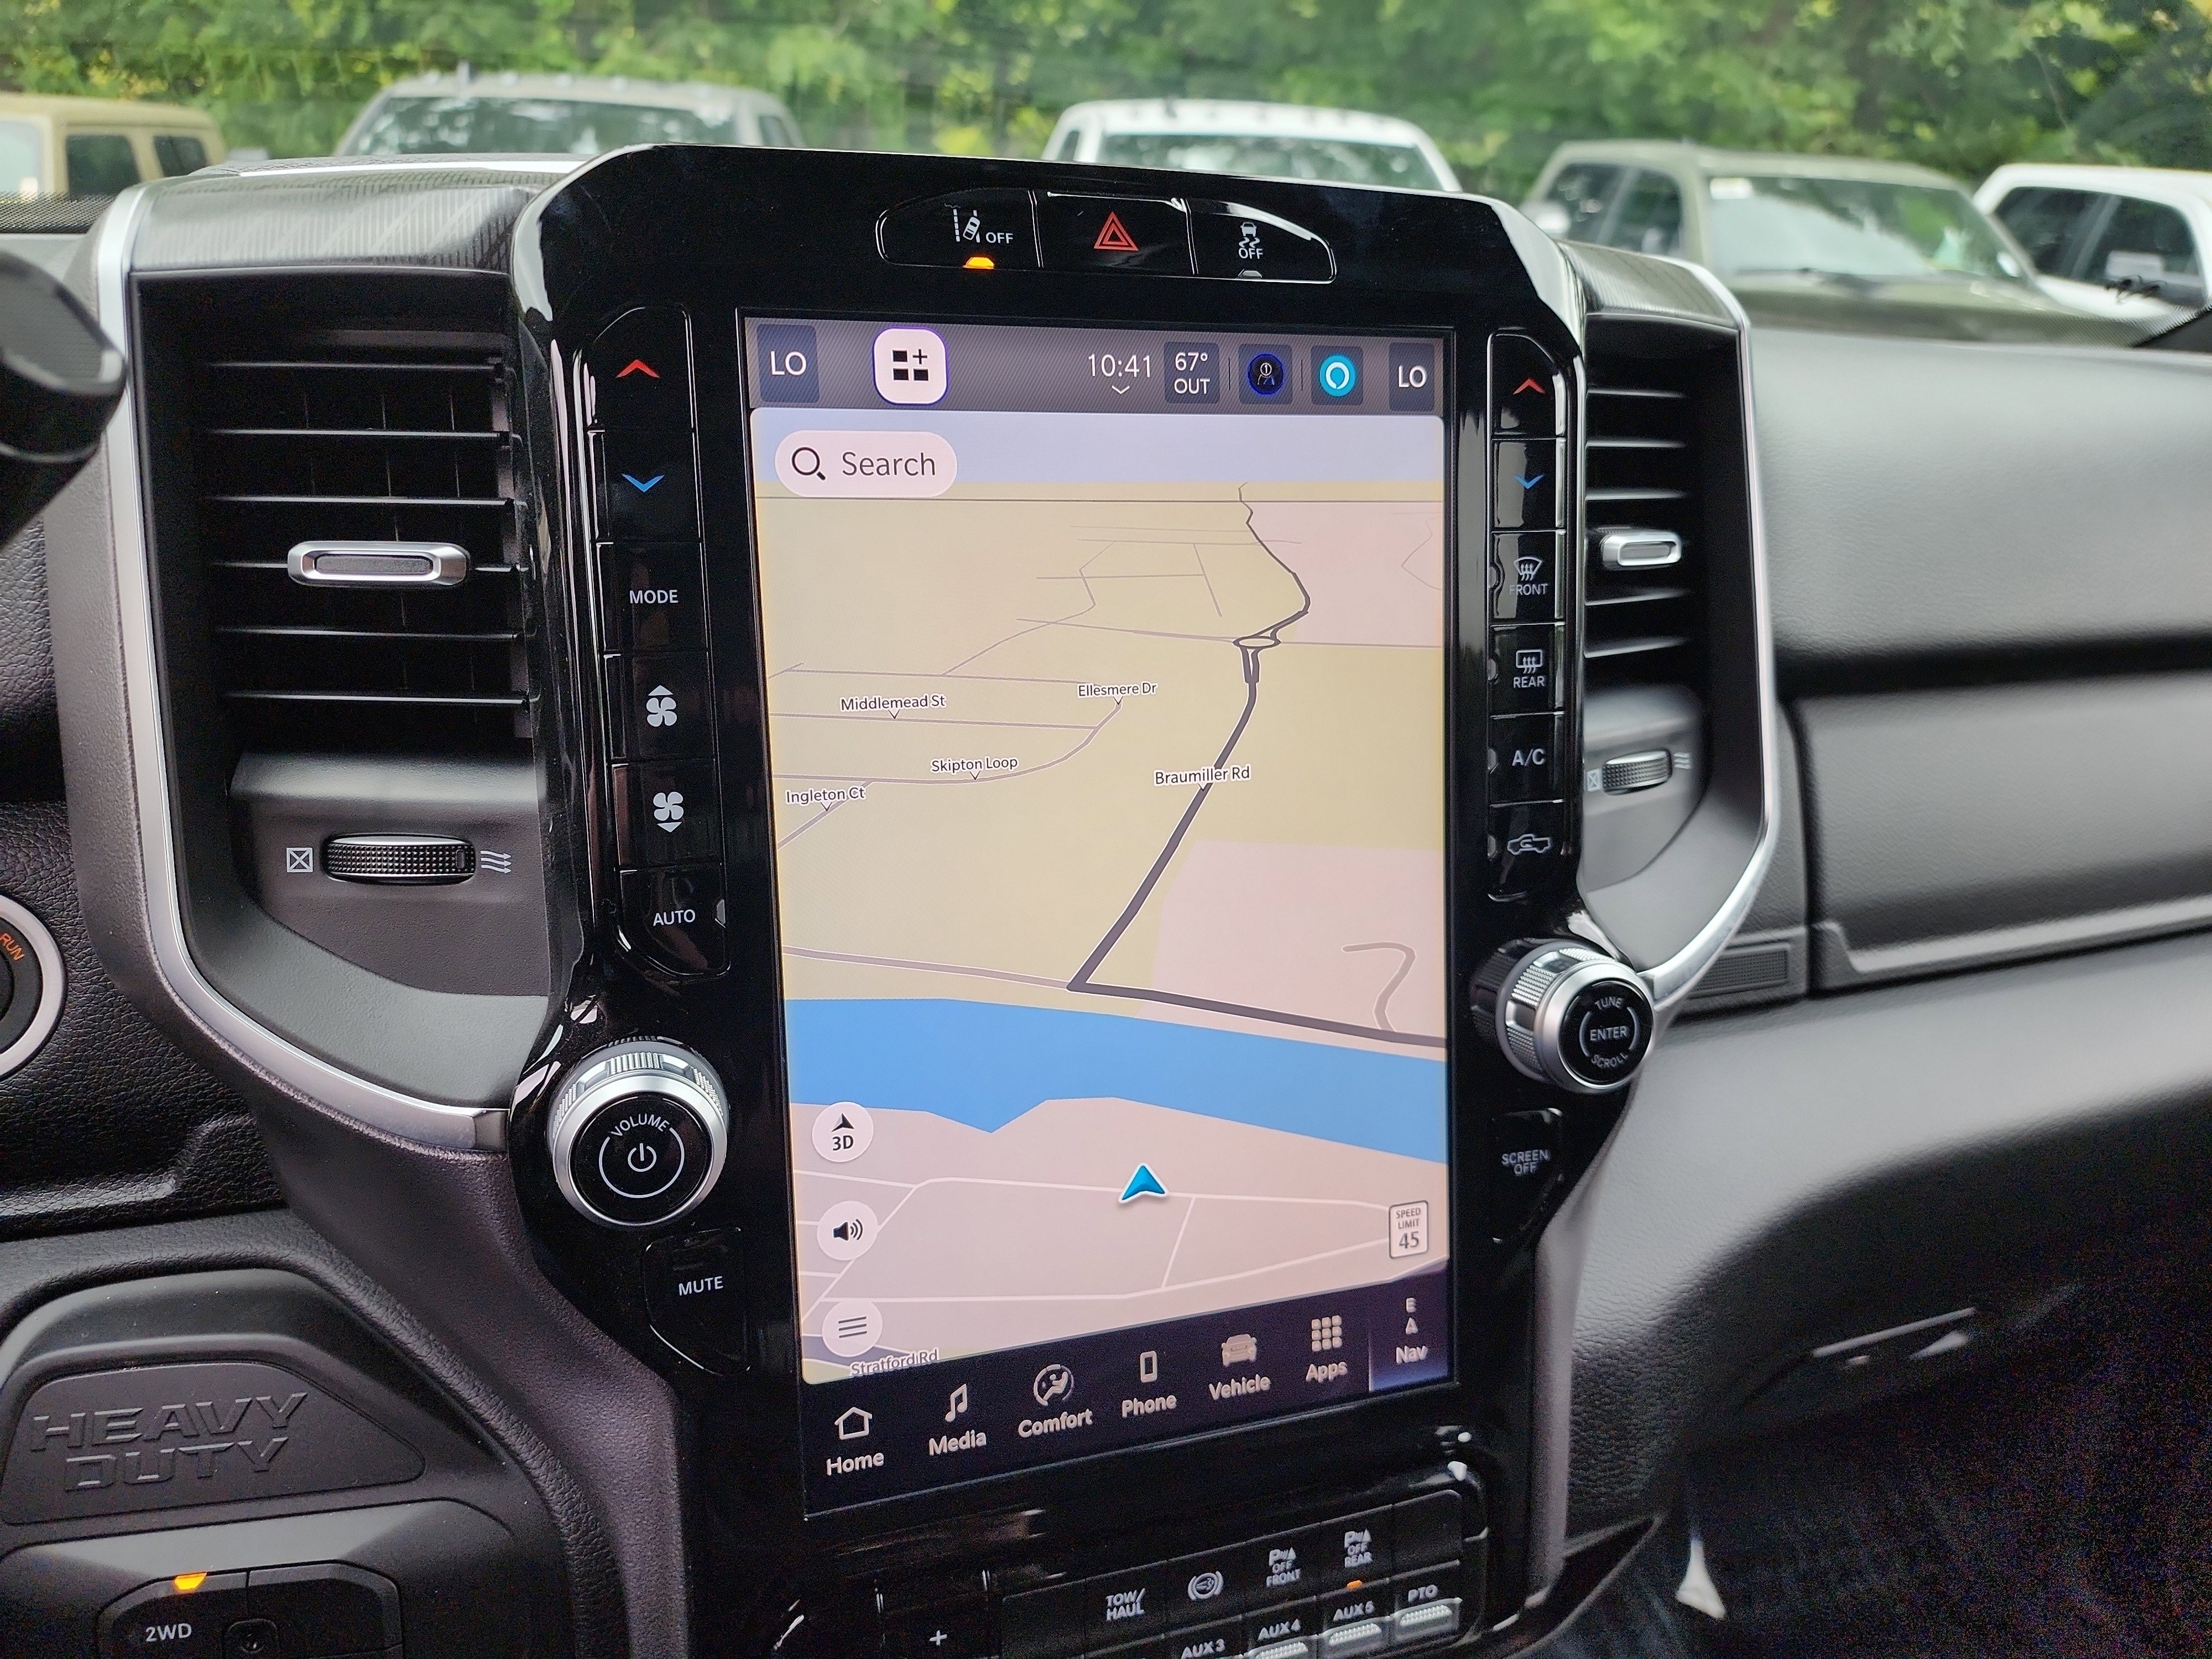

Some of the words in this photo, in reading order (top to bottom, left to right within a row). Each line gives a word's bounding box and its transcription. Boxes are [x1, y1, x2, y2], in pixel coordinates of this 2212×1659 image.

[986, 232, 1014, 244] OFF
[1238, 247, 1263, 260] OFF
[770, 351, 807, 377] LO
[1087, 354, 1152, 378] 10:41
[1175, 352, 1209, 372] 67°
[1174, 378, 1211, 395] OUT
[1397, 365, 1427, 388] LO
[841, 451, 936, 477] Search
[629, 589, 679, 604] MODE
[1509, 583, 1549, 596] FRONT
[1078, 685, 1139, 697] Ellesmere
[1142, 682, 1157, 694] Dr
[1512, 676, 1546, 689] REAR
[840, 696, 928, 712] Middlemead
[931, 695, 946, 707] St
[931, 758, 983, 773] Skipton
[986, 757, 1019, 771] Loop
[1511, 748, 1546, 767] A/C
[1155, 768, 1228, 785] Braumiller
[1232, 765, 1250, 779] Rd
[786, 789, 846, 805] Ingleton
[849, 786, 865, 800] Ct
[652, 909, 696, 927] AUTO
[1594, 995, 1623, 1011] TUNE
[1589, 1025, 1628, 1042] ENTER
[1590, 1051, 1630, 1068] SCROLL
[611, 1113, 671, 1139] VOLUME
[832, 1134, 854, 1152] 3D
[1501, 1149, 1550, 1166] SCREEN
[1513, 1163, 1537, 1177] OFF
[1395, 1207, 1421, 1219] SPEED
[1397, 1218, 1420, 1230] LIMIT
[1398, 1230, 1420, 1249] 45
[678, 1275, 724, 1296] MUTE
[850, 1351, 917, 1376] Stratford
[918, 1348, 940, 1365] Rd
[1395, 1345, 1428, 1365] Nav
[1306, 1360, 1348, 1383] Apps
[1209, 1373, 1271, 1401] Vehicle
[1121, 1392, 1177, 1418] Phone
[29, 1392, 308, 1452] HEAVY
[1018, 1408, 1093, 1438] Comfort
[928, 1430, 987, 1456] Media
[64, 1437, 289, 1493] DUTY
[826, 1450, 885, 1476] Home
[1344, 1552, 1374, 1568] REAR
[1266, 1568, 1301, 1588] FRONT
[1105, 1588, 1146, 1608] TOW/
[1407, 1584, 1438, 1604] PTO
[1105, 1601, 1145, 1622] HAUL
[1333, 1602, 1364, 1622] AUX
[145, 1622, 192, 1643] 2WD
[1257, 1621, 1291, 1641] AUX
[1181, 1640, 1215, 1659] AUX
[1215, 1638, 1226, 1652] 3
